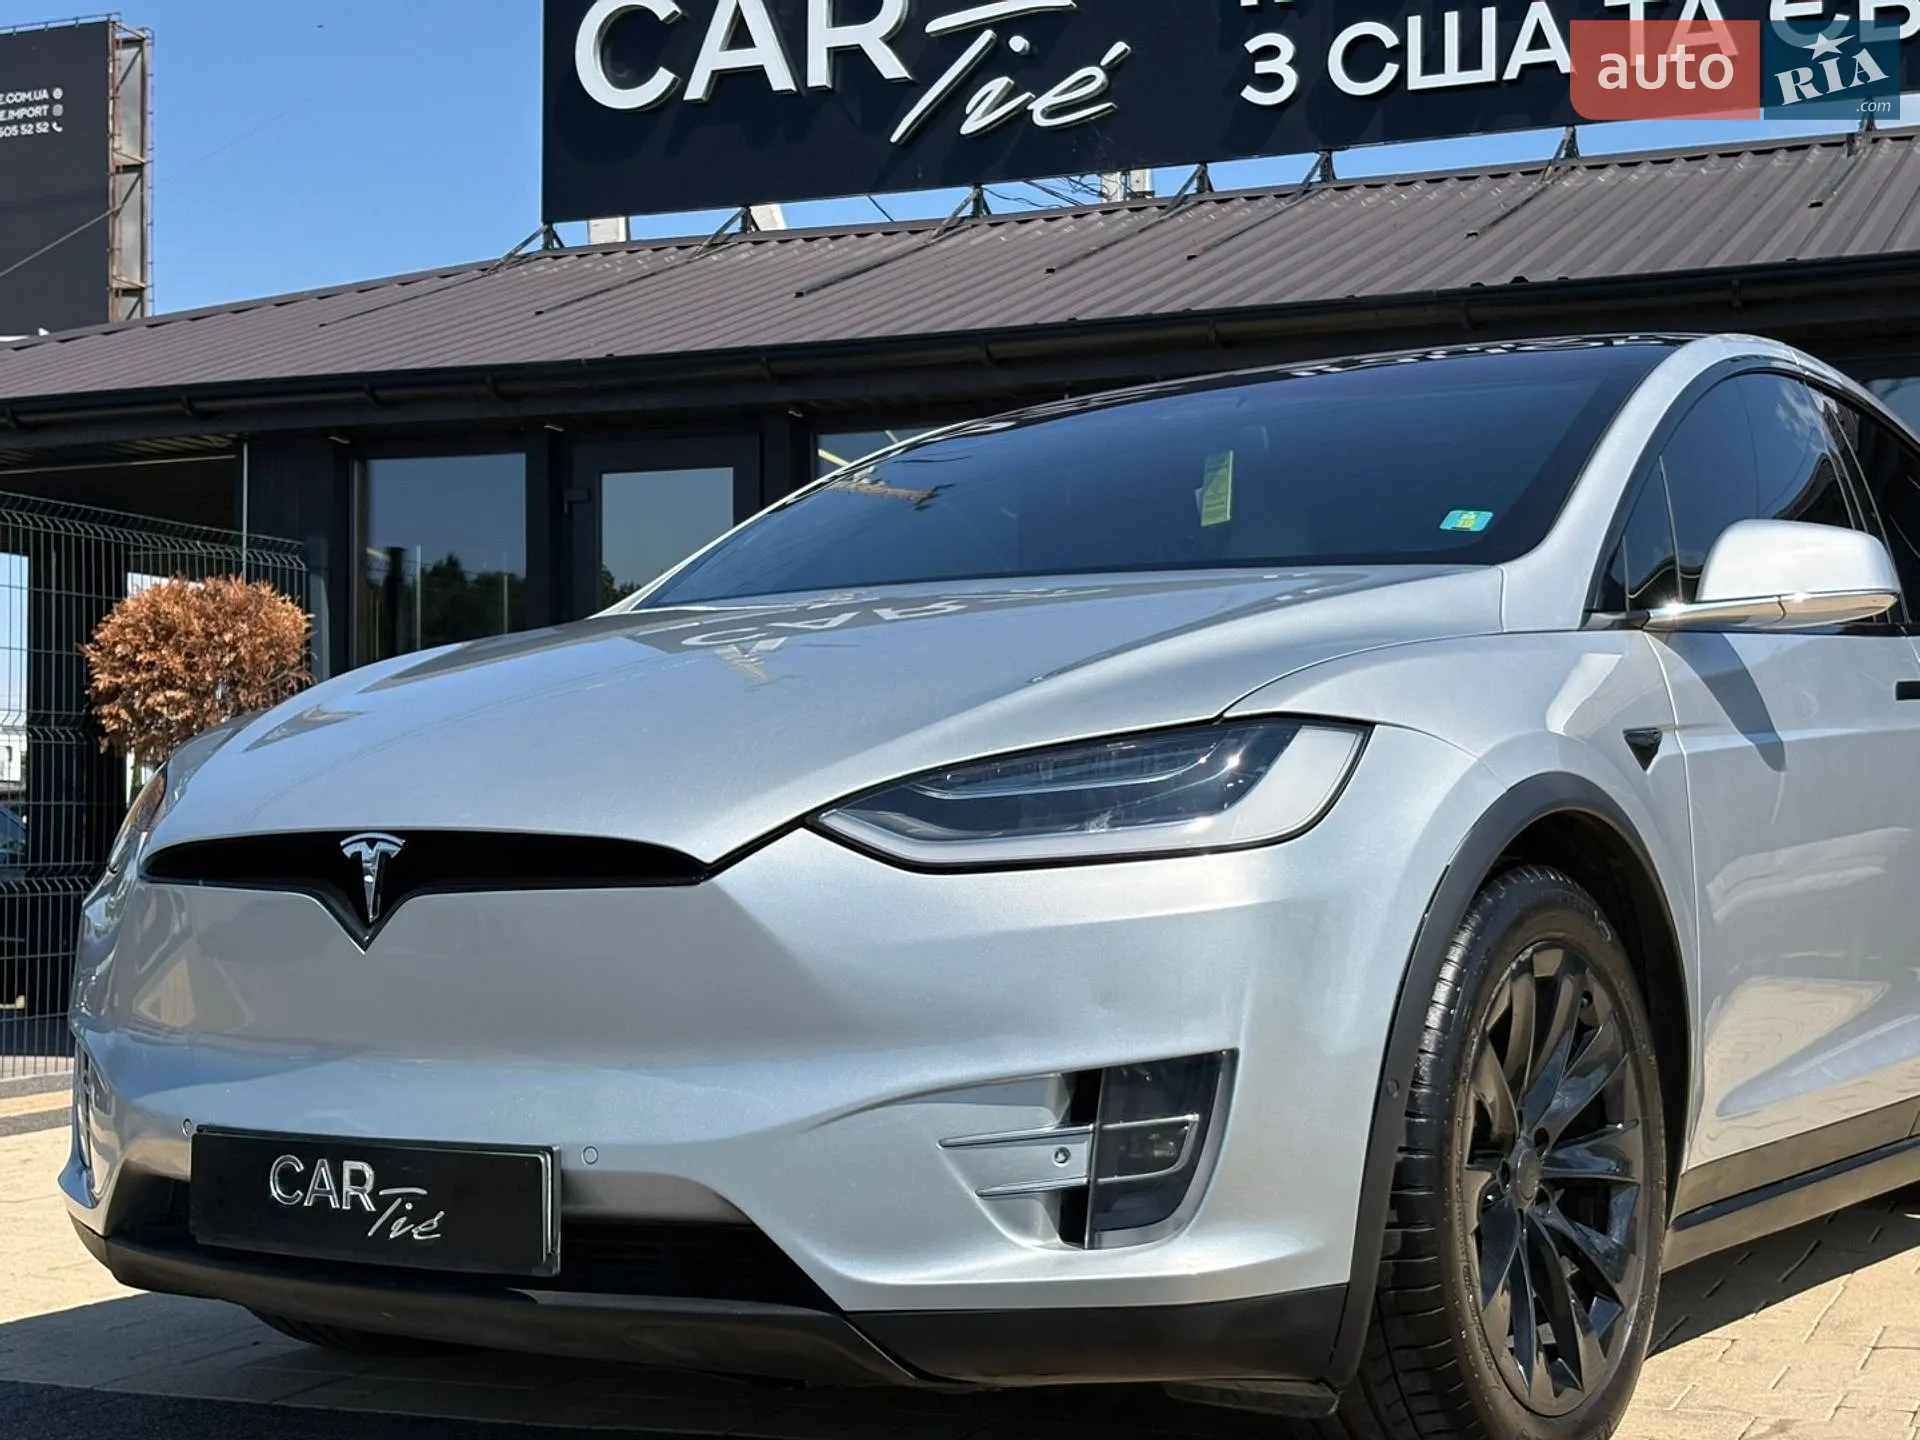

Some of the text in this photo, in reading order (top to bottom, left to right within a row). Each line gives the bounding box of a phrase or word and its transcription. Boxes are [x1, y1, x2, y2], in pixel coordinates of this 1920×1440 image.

[574, 0, 914, 112] CAR
[1327, 1, 1577, 96] США
[269, 1154, 376, 1212] CAR
